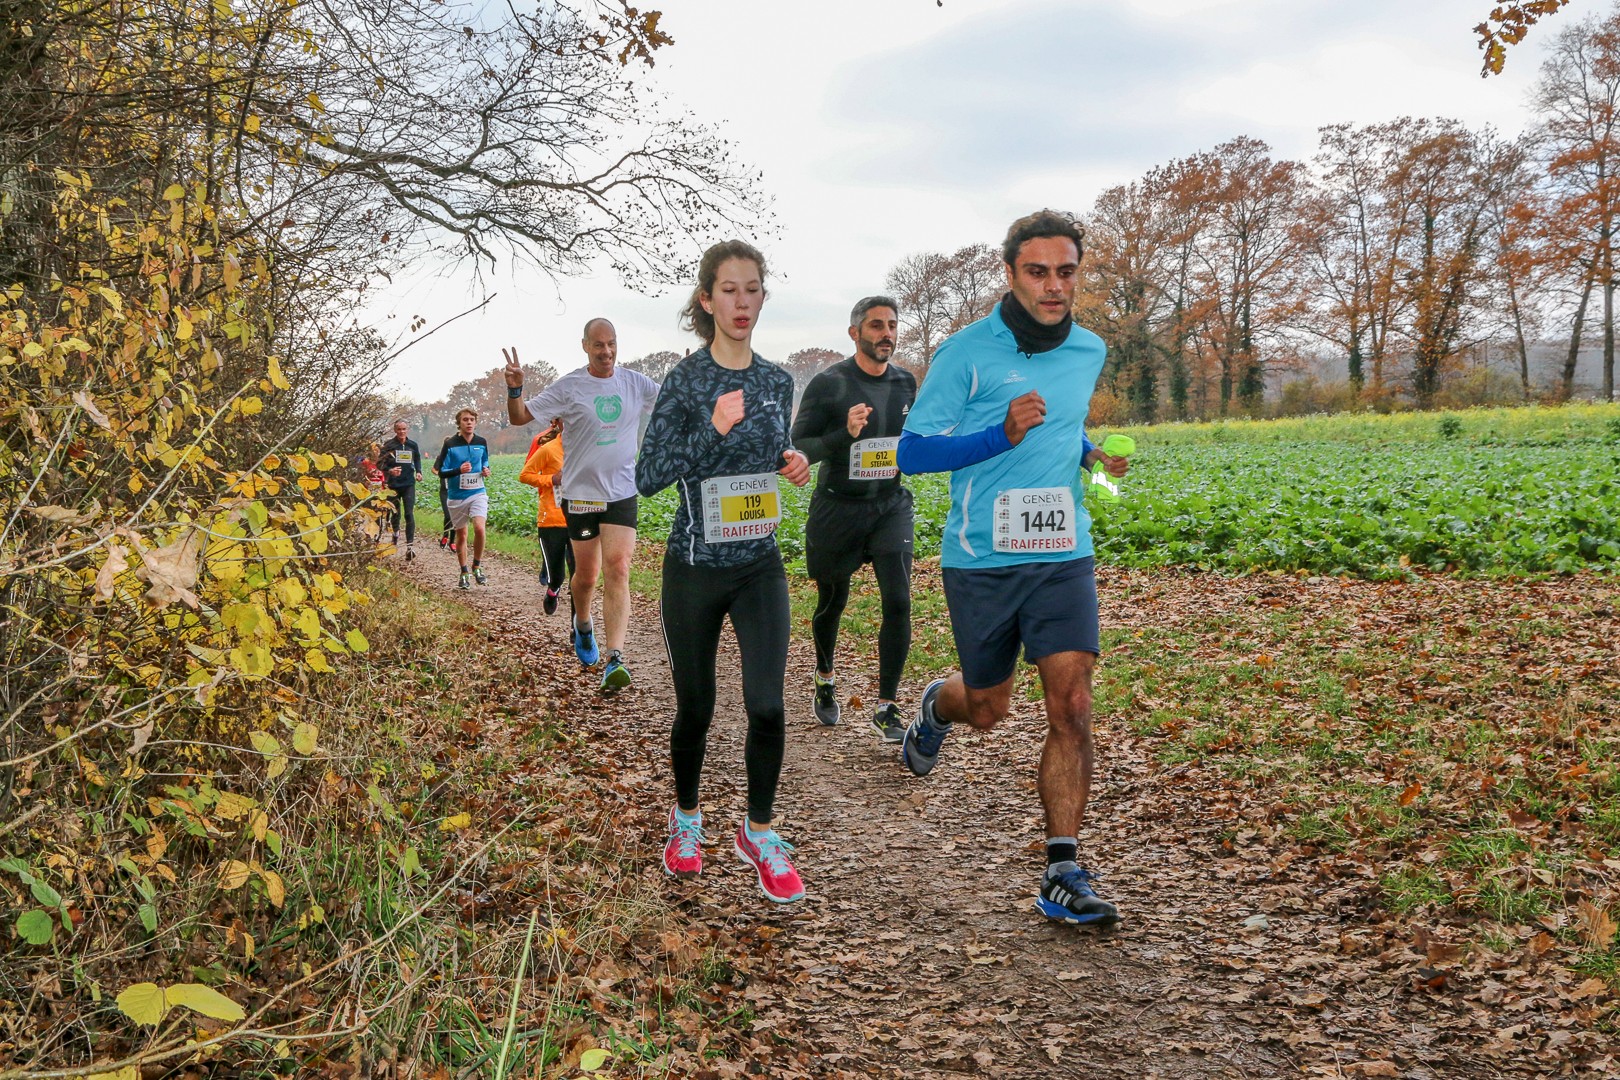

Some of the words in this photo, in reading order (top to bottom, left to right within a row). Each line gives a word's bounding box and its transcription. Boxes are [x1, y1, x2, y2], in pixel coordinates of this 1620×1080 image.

[875, 451, 888, 460] 612
[870, 460, 893, 468] STEFANO
[743, 494, 762, 509] 119
[739, 509, 766, 521] LOUISA
[1020, 509, 1066, 533] 1442
[722, 521, 778, 538] RAIFFEISEN
[1010, 537, 1073, 549] RAIFFEISEN
